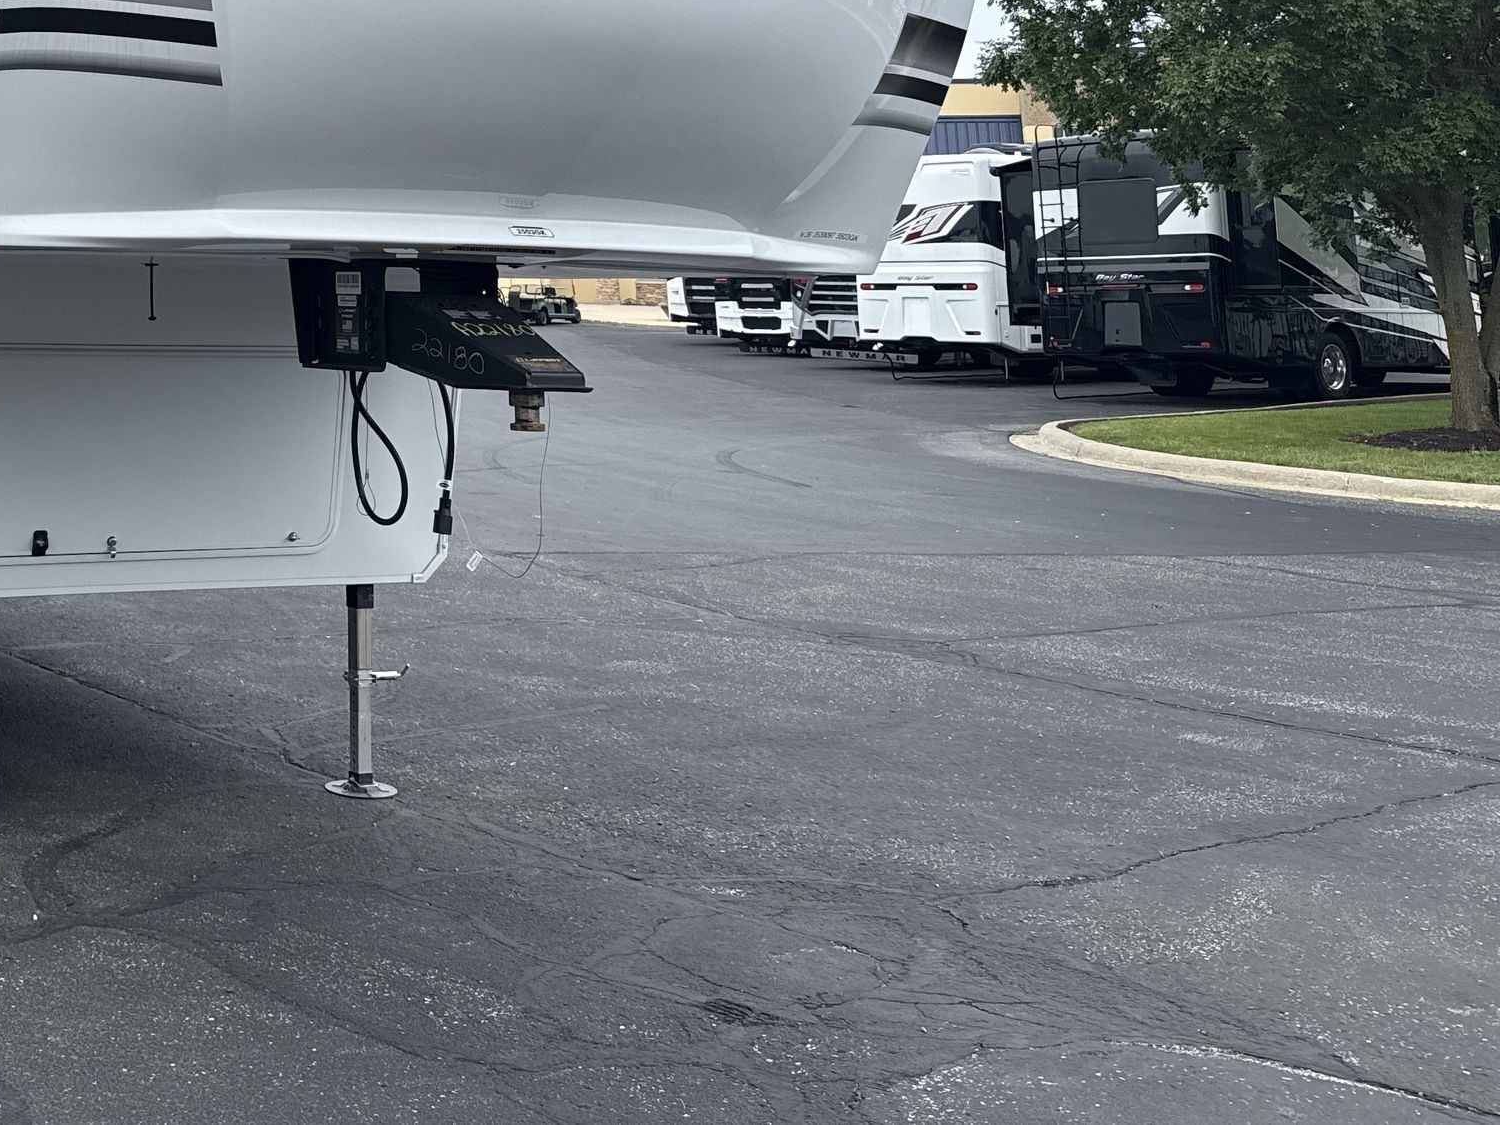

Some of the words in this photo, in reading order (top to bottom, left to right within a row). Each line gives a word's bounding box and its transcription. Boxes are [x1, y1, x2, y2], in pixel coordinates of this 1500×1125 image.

[1095, 273, 1116, 282] Bay
[1119, 273, 1144, 281] Star
[411, 328, 485, 375] 22180
[749, 346, 810, 355] NEWMA
[821, 349, 906, 362] NEWMAR
